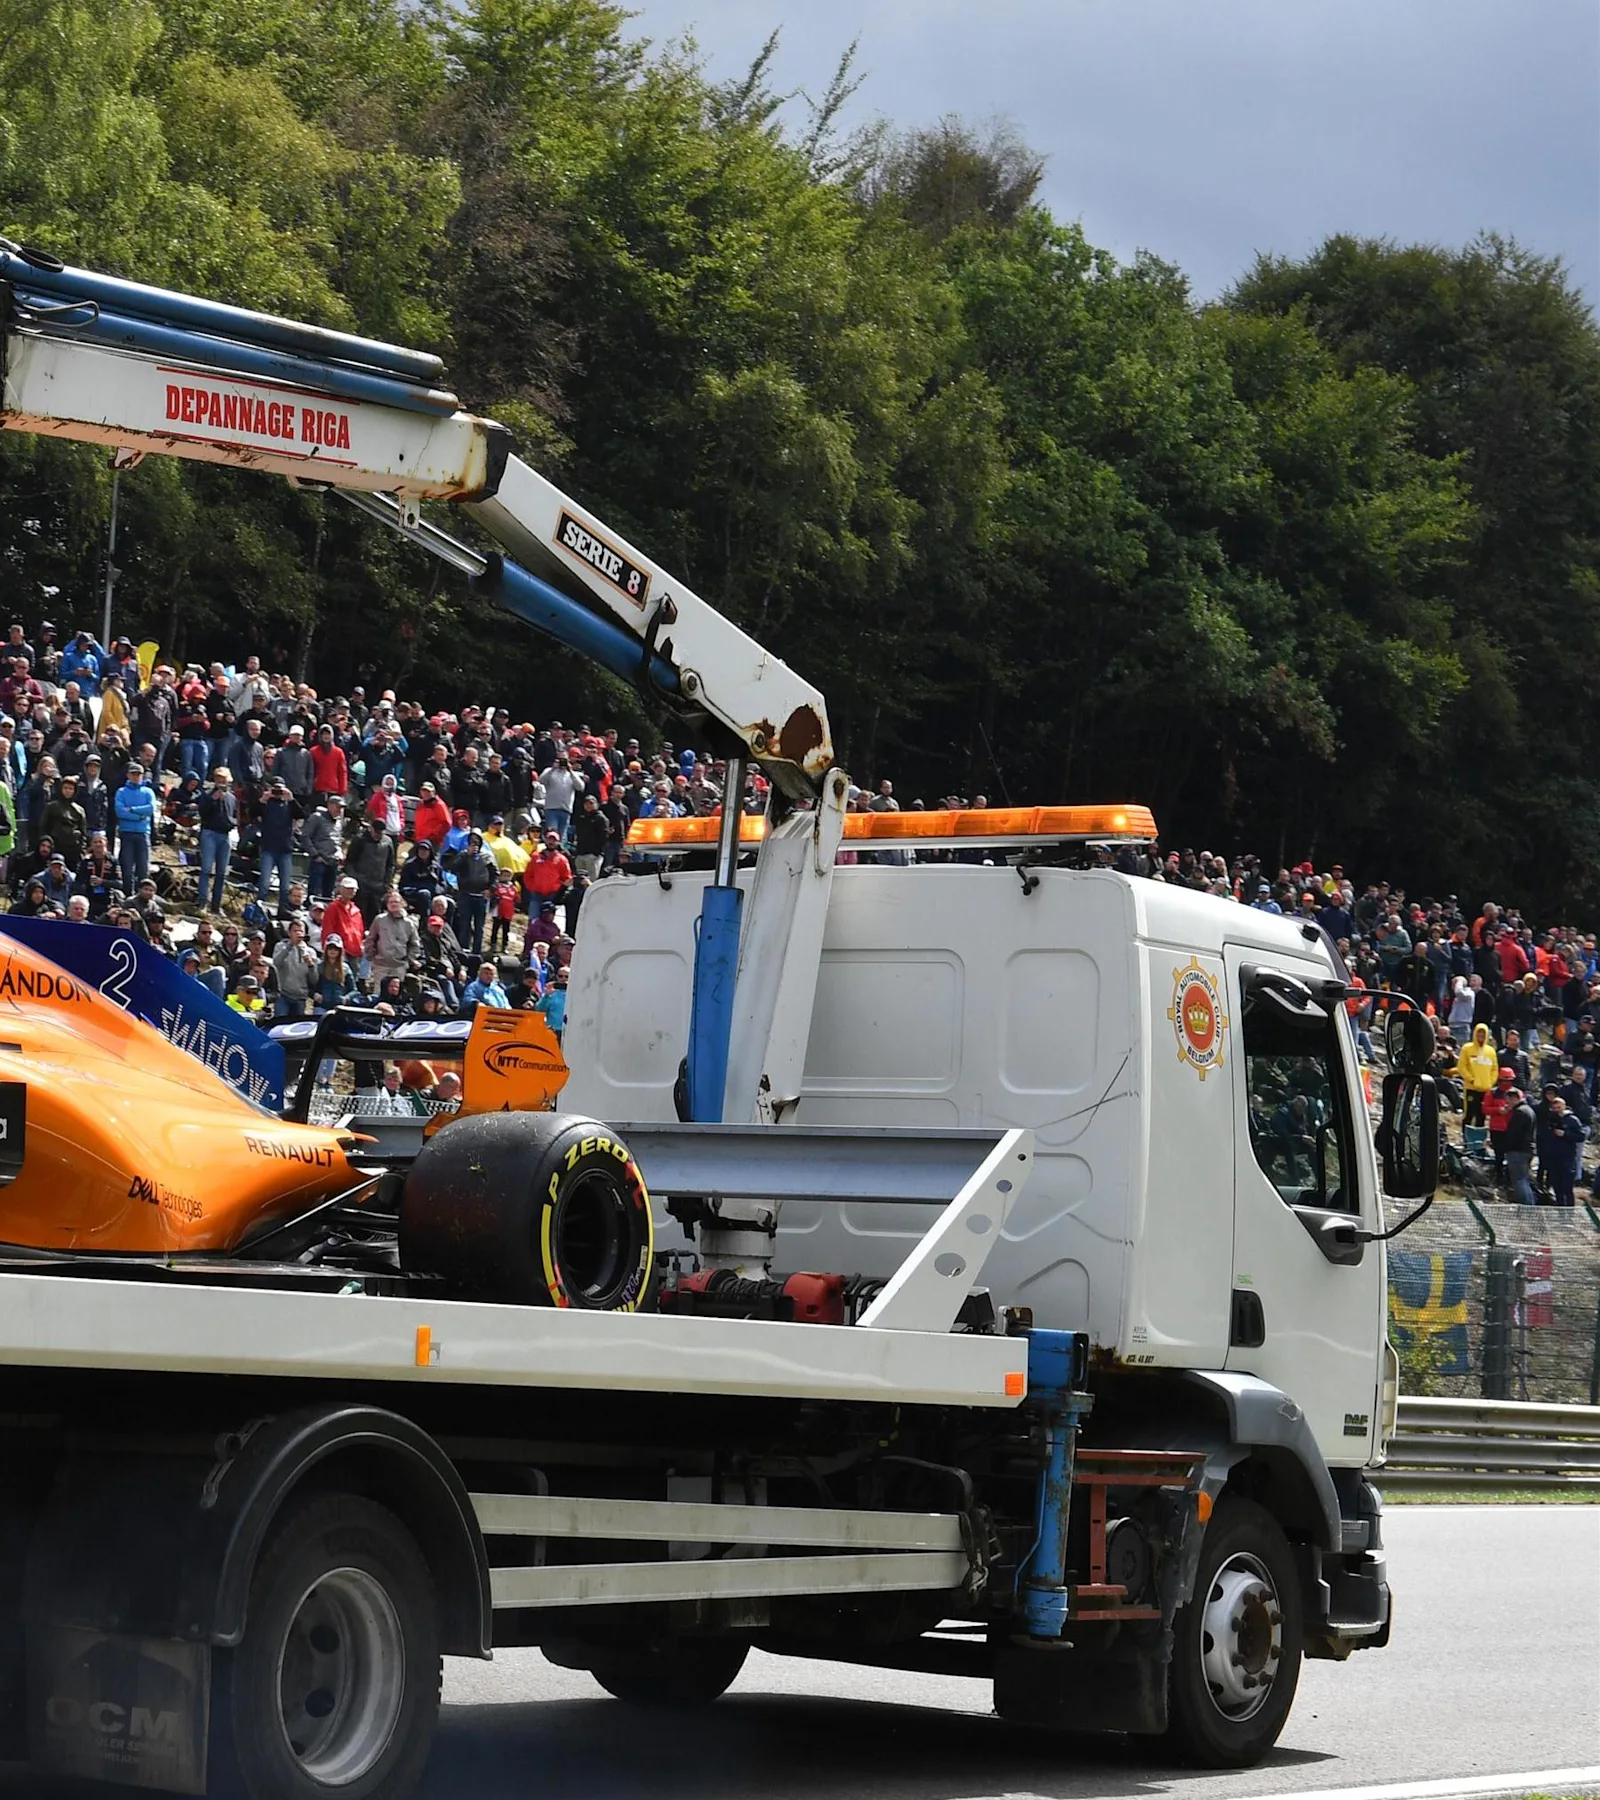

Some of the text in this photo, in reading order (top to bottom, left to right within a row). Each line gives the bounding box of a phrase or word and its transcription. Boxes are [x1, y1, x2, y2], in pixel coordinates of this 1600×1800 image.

[166, 385, 351, 450] DEPANNAGE RIGA
[562, 521, 641, 595] SERIE 8
[99, 938, 138, 1012] 2
[1179, 972, 1216, 1001] AUTOMOBILE
[1175, 995, 1184, 1034] ROYAL
[497, 1055, 519, 1068] NTT
[1187, 1045, 1215, 1063] BELGIUM
[244, 1135, 334, 1168] RENAULT
[549, 1136, 629, 1204] P ZERO
[128, 1175, 160, 1205] DELL
[1344, 1413, 1369, 1425] DAF
